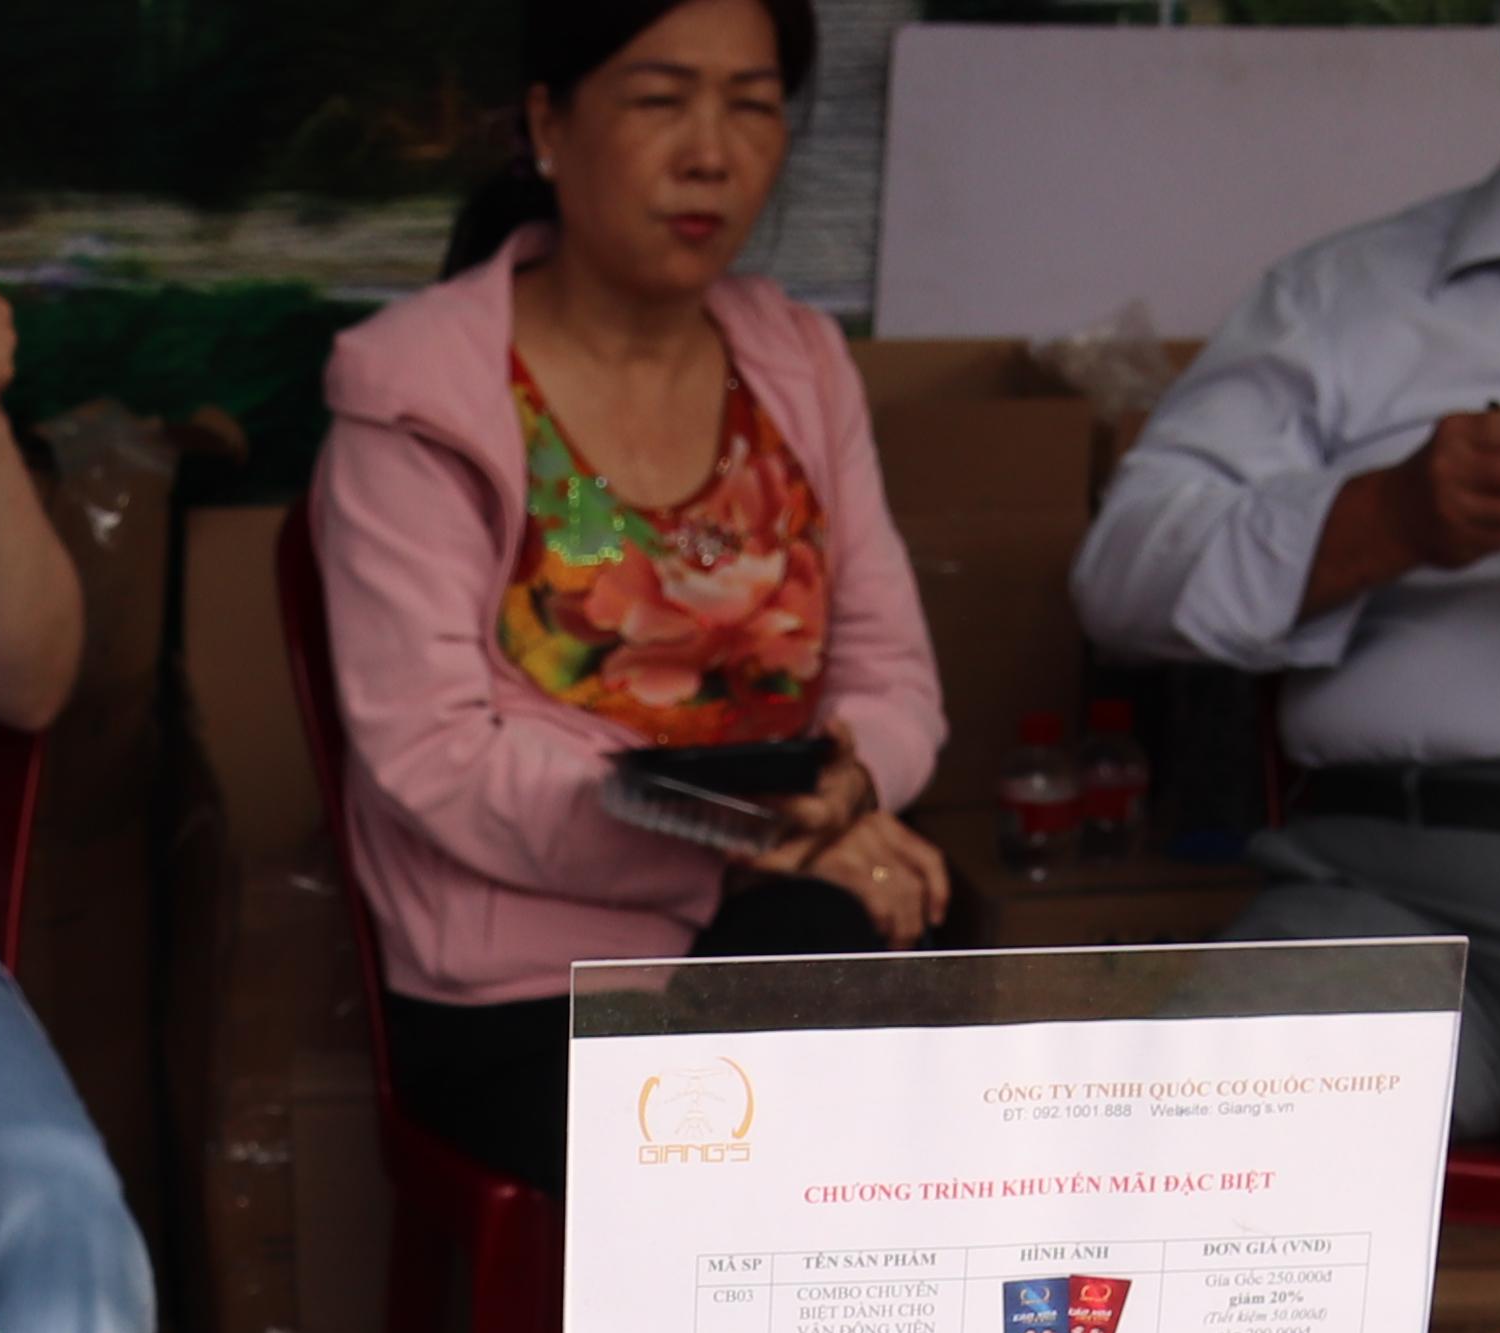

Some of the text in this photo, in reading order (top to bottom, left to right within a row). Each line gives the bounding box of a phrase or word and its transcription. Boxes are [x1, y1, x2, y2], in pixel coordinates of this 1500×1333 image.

[983, 1074, 1400, 1104] CÔNG TY TNHH QUỐC CƠ QUỐC NGHIỆP
[804, 1170, 1276, 1205] CHƯƠNG TRÌNH KHUYẾN MÃI ĐẶC BIỆT
